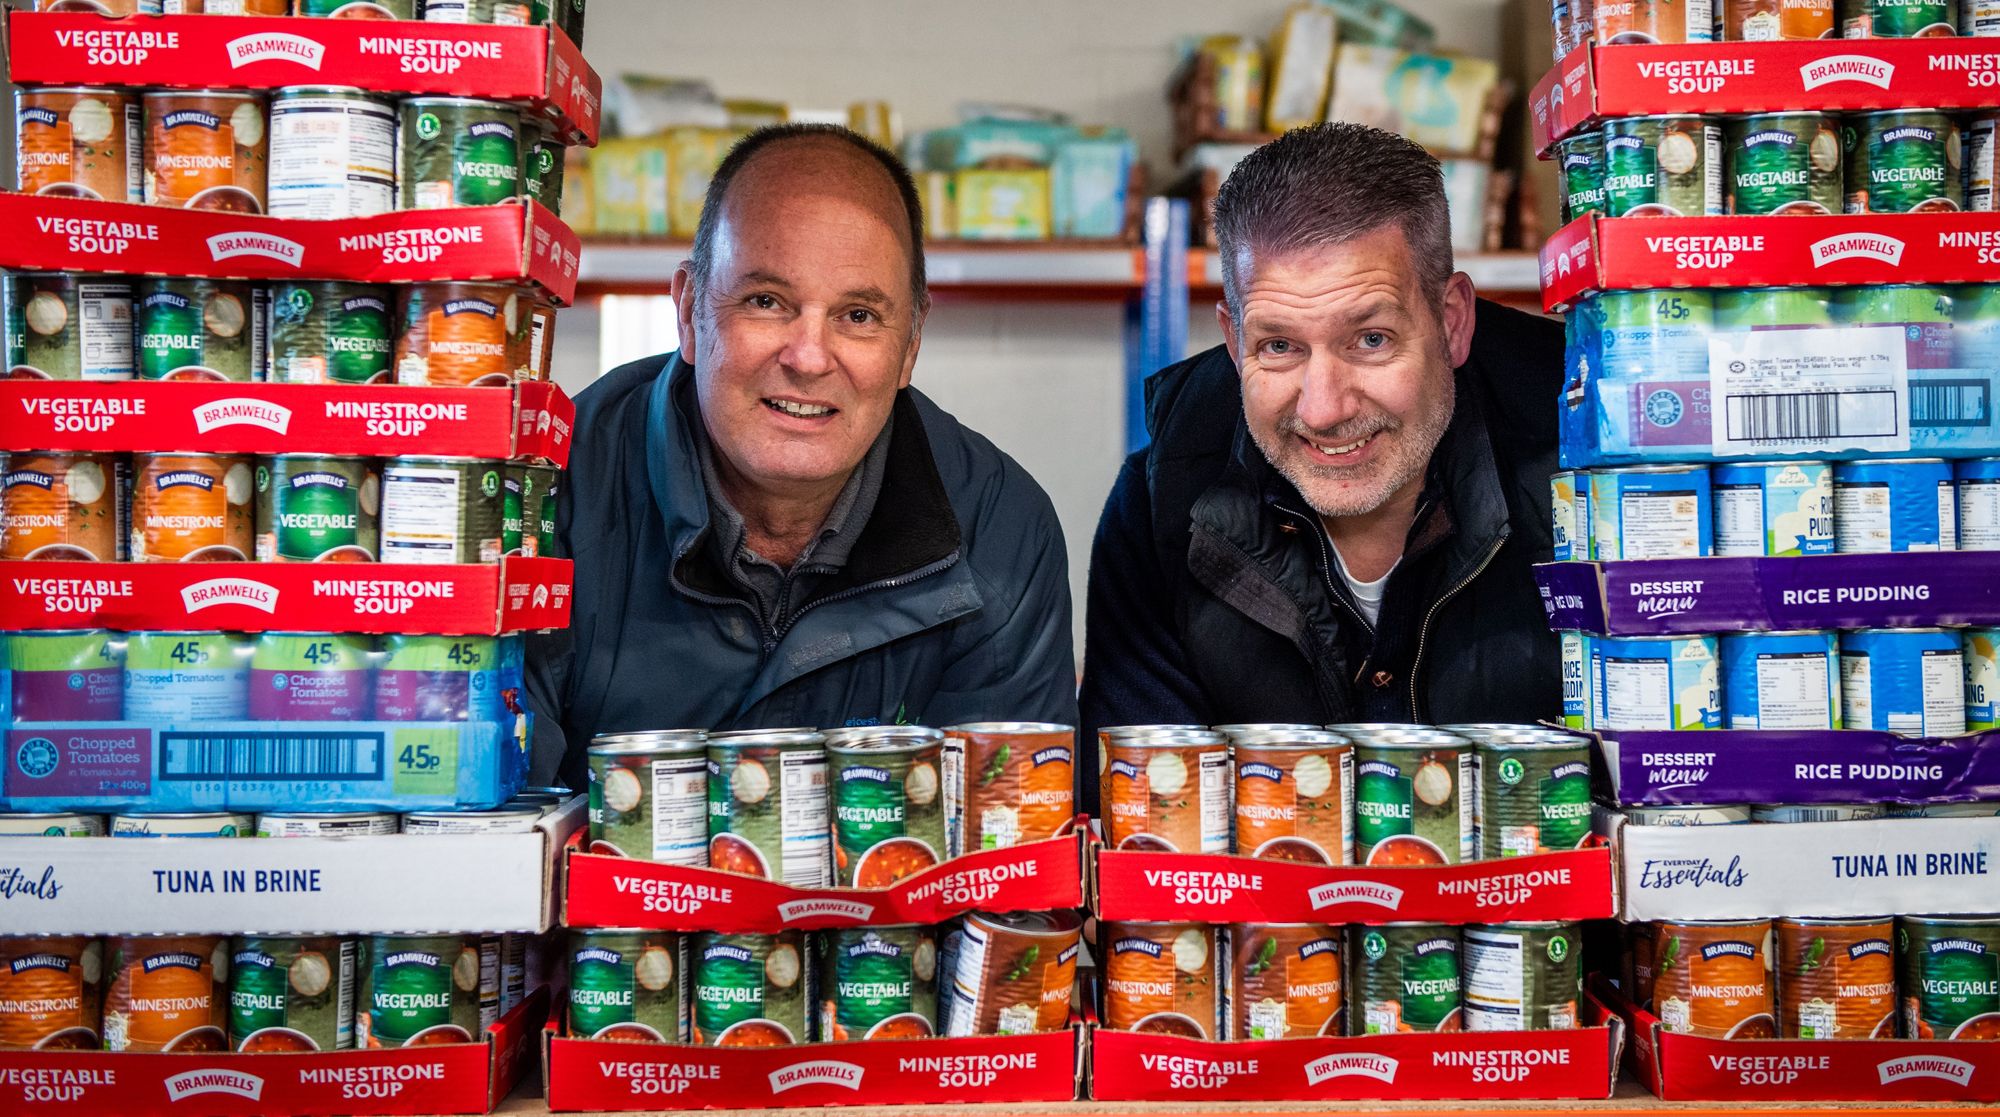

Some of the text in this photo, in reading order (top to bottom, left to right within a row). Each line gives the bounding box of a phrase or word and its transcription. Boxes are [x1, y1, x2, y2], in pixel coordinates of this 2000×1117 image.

[55, 30, 179, 49] VEGETABLE
[359, 37, 502, 58] MINESTRONE
[87, 48, 148, 65] SOUP
[236, 40, 315, 59] BRAMWELLS
[400, 56, 461, 74] SOUP
[1637, 59, 1755, 78] VEGETABLE
[1928, 55, 2000, 71] MINEST
[1810, 62, 1885, 81] BRAMWELLS
[1668, 77, 1725, 94] SOUP
[165, 110, 219, 126] BRAMWELLS
[1745, 132, 1795, 148] BRAMWELLS
[1883, 128, 1934, 143] BRAMWELLS
[156, 153, 232, 168] MINESTRONE
[457, 161, 518, 181] VEGETABLE
[1737, 171, 1807, 187] VEGETABLE
[1872, 167, 1944, 182] VEGETABLE
[37, 216, 159, 240] VEGETABLE
[68, 236, 129, 254] SOUP
[339, 226, 483, 252] MINESTRONE
[1645, 236, 1764, 252] VEGETABLE
[1939, 232, 2000, 247] MINES
[217, 239, 294, 258] BRAMWELLS
[382, 245, 443, 264] SOUP
[1820, 239, 1896, 258] BRAMWELLS
[1978, 249, 2000, 264] SO
[1676, 253, 1734, 269] SOUP
[1657, 298, 1690, 320] 45p
[430, 341, 504, 356] MINESTRONE
[21, 399, 146, 415] VEGETABLE
[203, 404, 281, 424] BRAMWELLS
[325, 402, 467, 420] MINESTRONE
[54, 416, 115, 432] SOUP
[366, 420, 426, 436] SOUP
[159, 473, 212, 487] BRAMWELLS
[292, 474, 345, 488] BRAMWELLS
[146, 515, 224, 529] MINESTRONE
[280, 513, 356, 528] VEGETABLE
[13, 579, 132, 596] VEGETABLE
[191, 584, 268, 603] BRAMWELLS
[313, 580, 453, 598] MINESTRONE
[1630, 581, 1704, 595] DESSERT
[1783, 585, 1930, 605] RICE PUDDING
[45, 596, 103, 612] SOUP
[353, 598, 413, 614] SOUP
[1638, 596, 1698, 614] menu
[304, 643, 341, 665] 45p
[447, 644, 480, 665] 45p
[1564, 660, 1581, 679] RICE
[290, 674, 346, 688] Chopped
[290, 686, 348, 699] Tomatoes
[67, 737, 136, 752] Chopped
[68, 751, 141, 764] Tomatoes
[398, 745, 440, 770] 45p
[1642, 753, 1716, 766] DESSERT
[842, 769, 889, 781] BRAMWELLS
[1649, 767, 1710, 784] menu
[1795, 764, 1943, 780] RICE PUDDING
[120, 781, 147, 793] 400g
[838, 806, 903, 822] VEGETABLE
[1359, 801, 1410, 819] EGETABLE
[1640, 855, 1749, 888] Essentials
[1832, 852, 1987, 878] TUNA IN BRINE
[0, 865, 62, 900] tials
[153, 869, 321, 893] TUNA IN BRINE
[907, 860, 1037, 904] MINESTRONE
[1144, 870, 1262, 890] VEGETABLE
[1438, 868, 1571, 895] MINESTRONE
[613, 876, 732, 903] VEGETABLE
[942, 884, 1000, 904] SOUP
[1175, 888, 1233, 904] SOUP
[1318, 886, 1394, 901] BRAMWELLS
[643, 896, 702, 914] SOUP
[1476, 889, 1532, 907] SOUP
[788, 902, 865, 917] BRAMWELLS
[1115, 941, 1158, 956] BRAMWELLS
[1705, 944, 1754, 957] BRAMWELLS
[1852, 942, 1890, 956] BRAMWELLS
[1931, 940, 1982, 953] BRAMWELLS
[14, 954, 68, 969] BRAMWELLS
[146, 953, 199, 968] BRAMWELLS
[386, 952, 439, 966] BRAMWELLS
[696, 985, 761, 1002] VEGETABLE
[839, 982, 909, 998] VEGETABLE
[1691, 984, 1764, 999] MINESTRONE
[1922, 979, 1998, 995] VEGETABLE
[0, 996, 79, 1013] MINESTRONE
[131, 996, 209, 1012] MINESTRONE
[233, 992, 284, 1010] EGETABLE
[375, 993, 450, 1009] VEGETABLE
[1952, 996, 1967, 1004] SOUP
[899, 1053, 1037, 1073] MINESTRONE
[1141, 1054, 1258, 1075] VEGETABLE
[1433, 1049, 1569, 1067] MINESTRONE
[1709, 1055, 1830, 1070] VEGETABLE
[300, 1064, 444, 1083] MINESTRONE
[600, 1062, 720, 1079] VEGETABLE
[1313, 1057, 1389, 1077] BRAMWELLS
[1472, 1066, 1530, 1082] SOUP
[1886, 1060, 1966, 1077] BRAMWELLS
[779, 1066, 854, 1085] BRAMWELLS
[939, 1071, 997, 1088] SOUP
[1170, 1073, 1228, 1089] SOUP
[1740, 1071, 1798, 1085] SOUP
[175, 1076, 254, 1093] BRAMWELLS
[343, 1083, 403, 1098] SOUP
[630, 1079, 690, 1094] SOUP
[24, 1086, 85, 1101] SOUP
